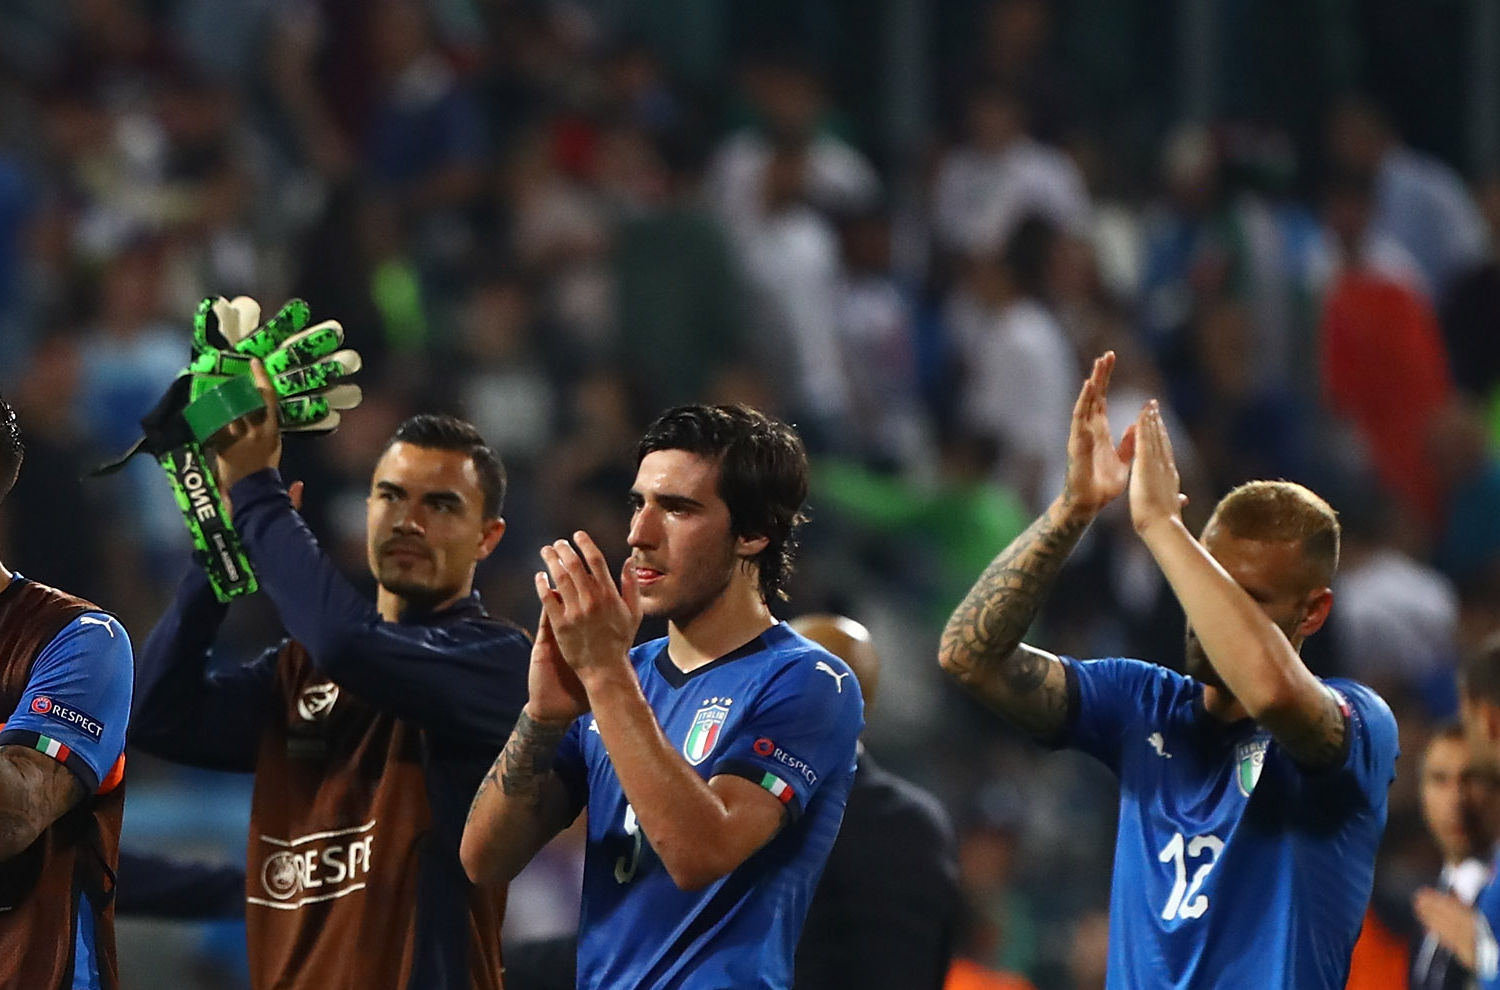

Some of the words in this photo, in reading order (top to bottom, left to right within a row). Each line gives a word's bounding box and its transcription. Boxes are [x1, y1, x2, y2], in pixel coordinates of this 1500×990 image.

[52, 704, 103, 736] RESPECT
[698, 711, 725, 721] ITALIA
[773, 747, 817, 785] RESPECT
[1158, 832, 1226, 920] 12
